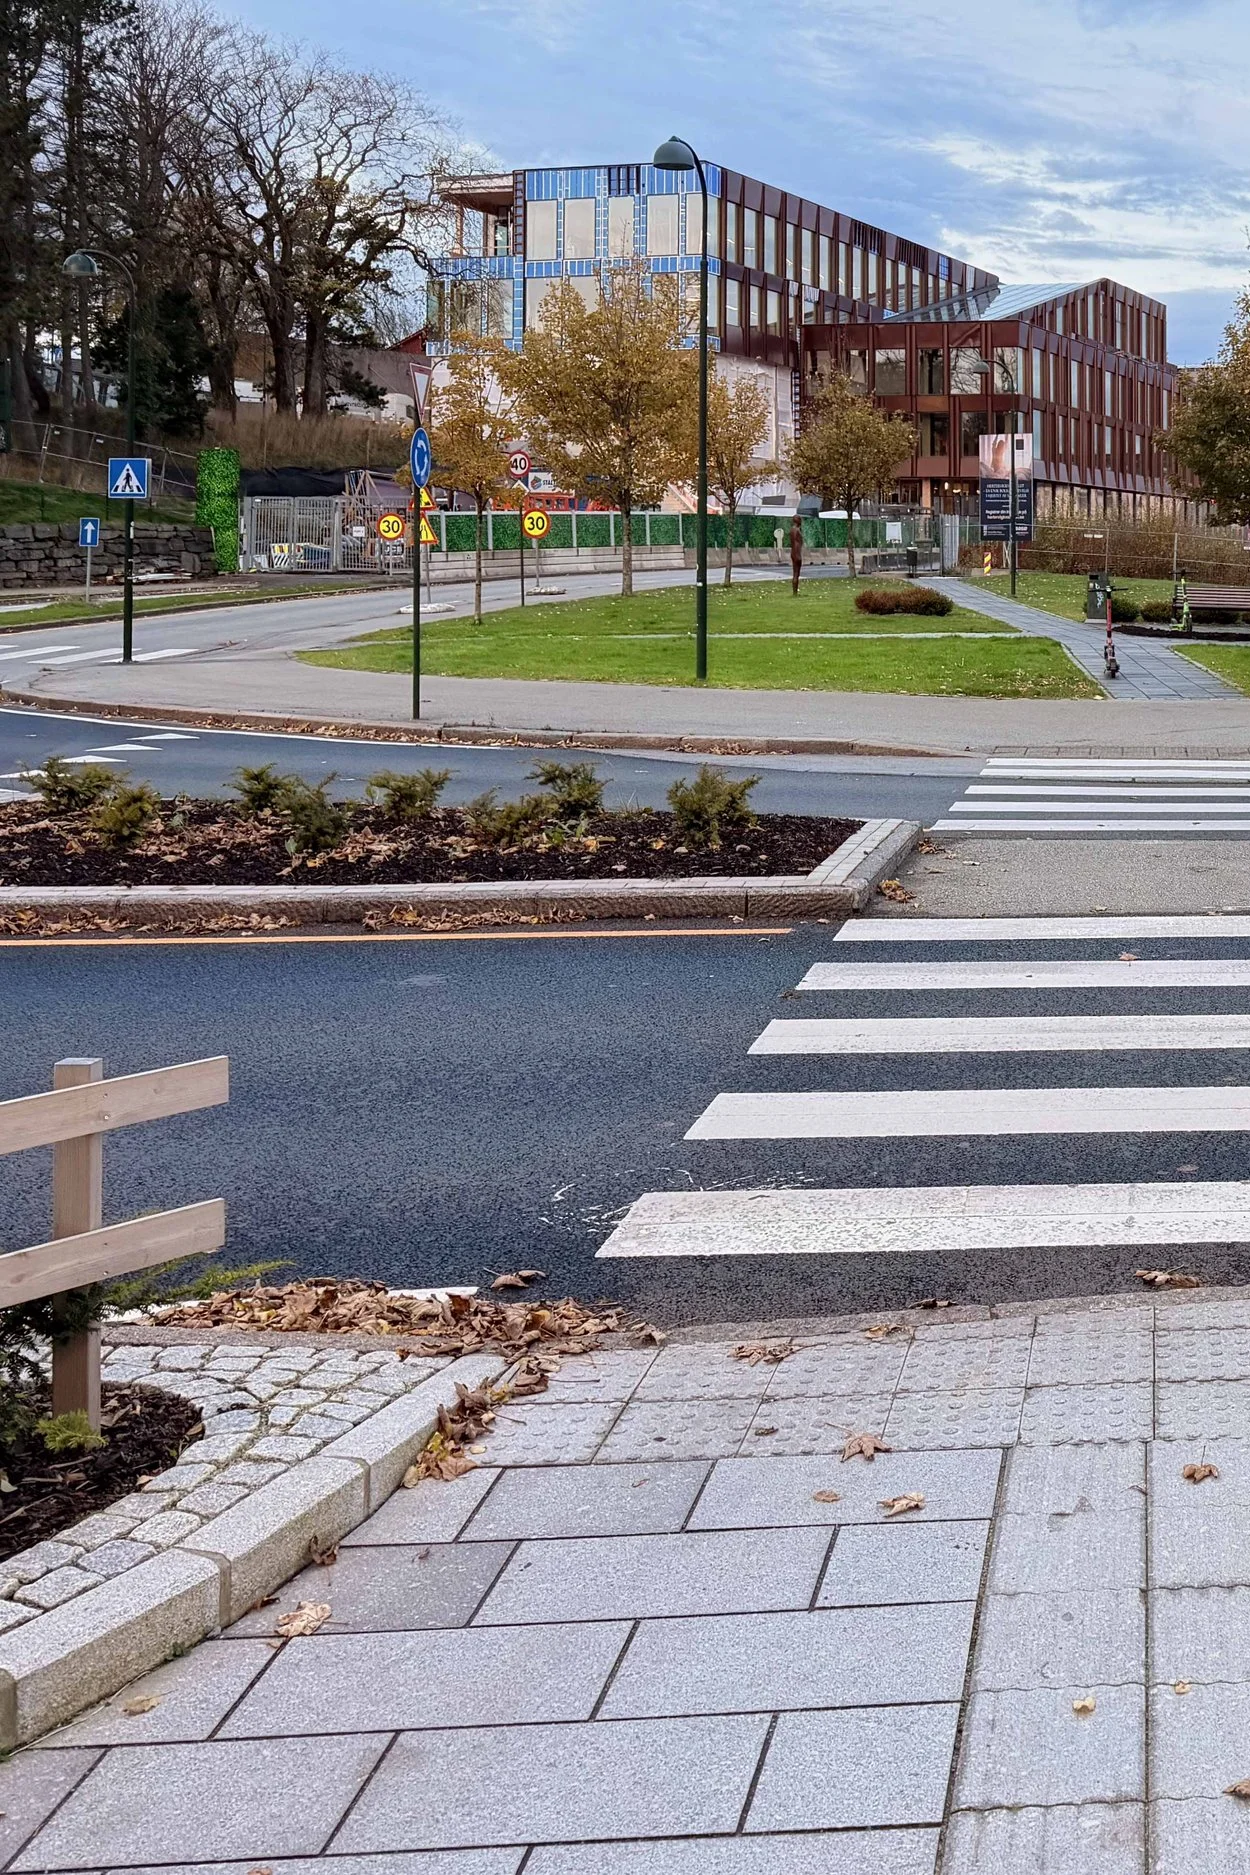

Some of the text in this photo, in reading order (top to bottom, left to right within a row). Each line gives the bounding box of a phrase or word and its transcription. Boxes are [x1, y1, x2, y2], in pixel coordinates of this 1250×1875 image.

[511, 457, 527, 470] 40
[382, 519, 400, 533] 30
[527, 516, 545, 531] 30
